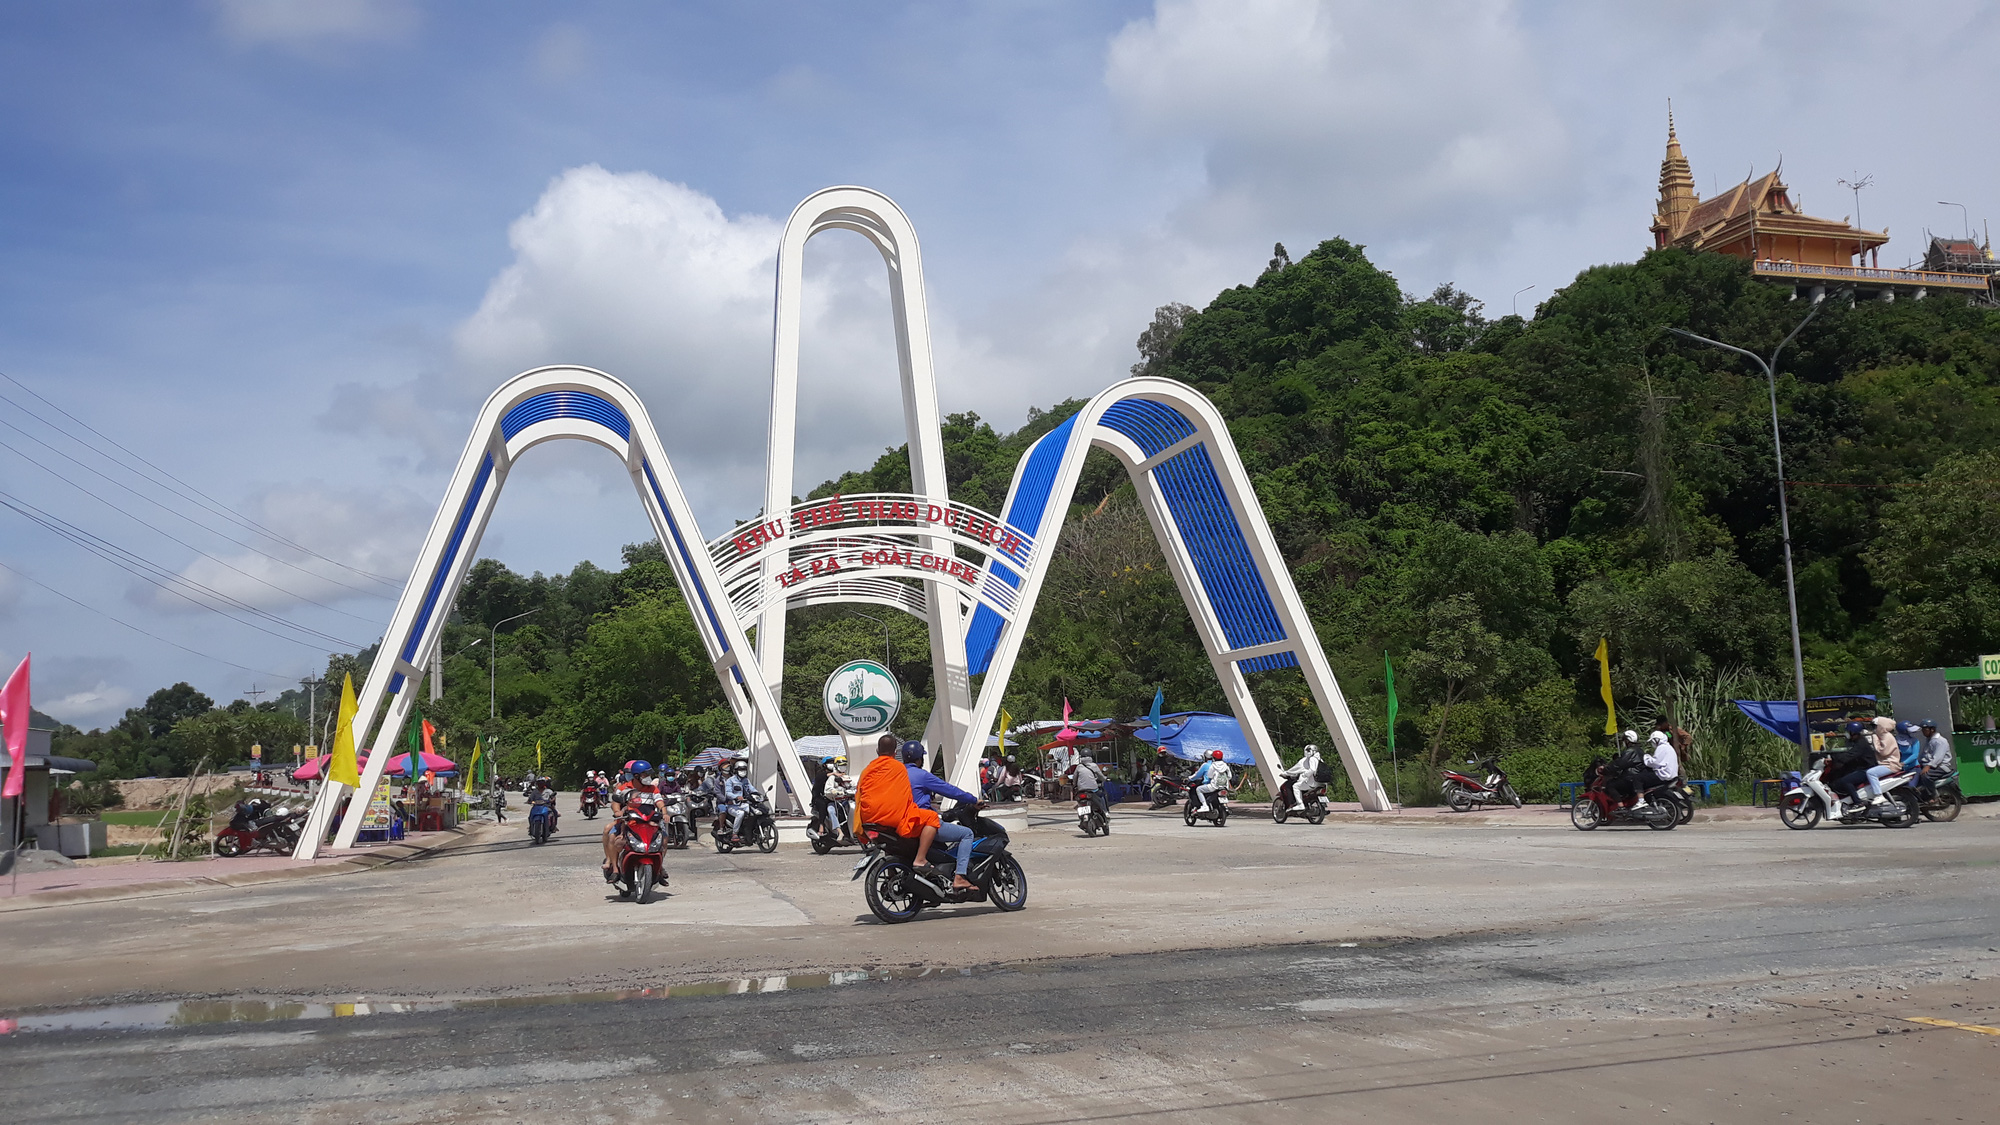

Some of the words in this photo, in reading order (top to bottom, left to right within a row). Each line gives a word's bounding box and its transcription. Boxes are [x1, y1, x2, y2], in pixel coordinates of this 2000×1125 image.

[731, 518, 785, 555] KHU
[792, 493, 845, 530] THỂ
[852, 501, 920, 521] THAO
[925, 504, 960, 527] DU
[964, 515, 1022, 555] LỊCH
[775, 562, 807, 588] TÀ
[810, 556, 841, 574] PẠ
[919, 554, 978, 584] CHEK
